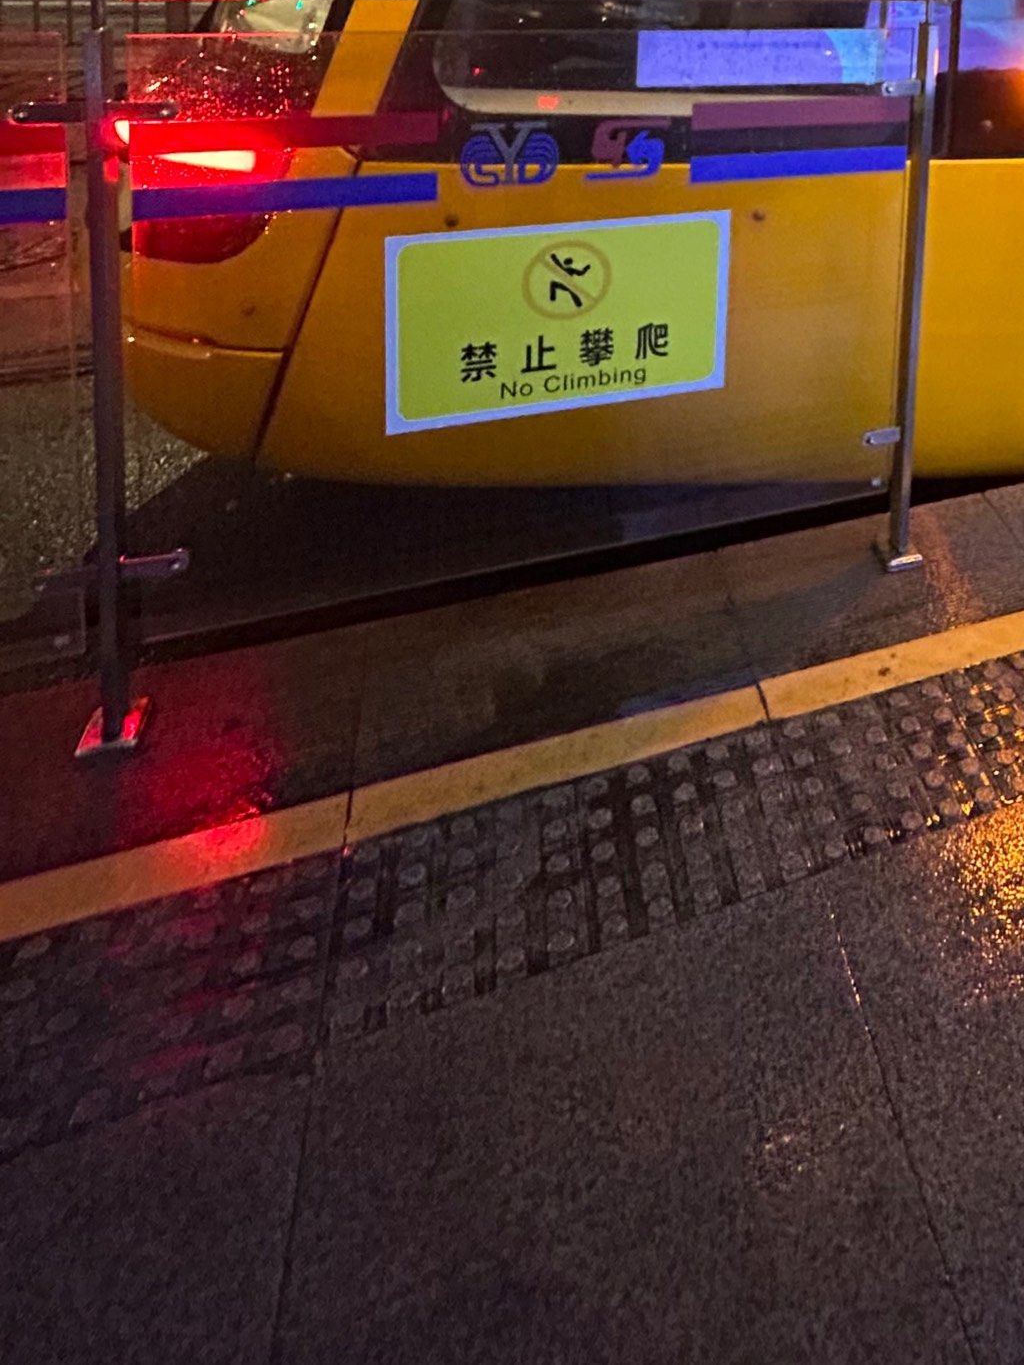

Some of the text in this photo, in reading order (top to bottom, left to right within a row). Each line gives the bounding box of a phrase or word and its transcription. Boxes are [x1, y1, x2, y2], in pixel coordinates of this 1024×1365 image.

[460, 322, 669, 383] 禁止攀爬
[500, 367, 647, 399] No Climbing
